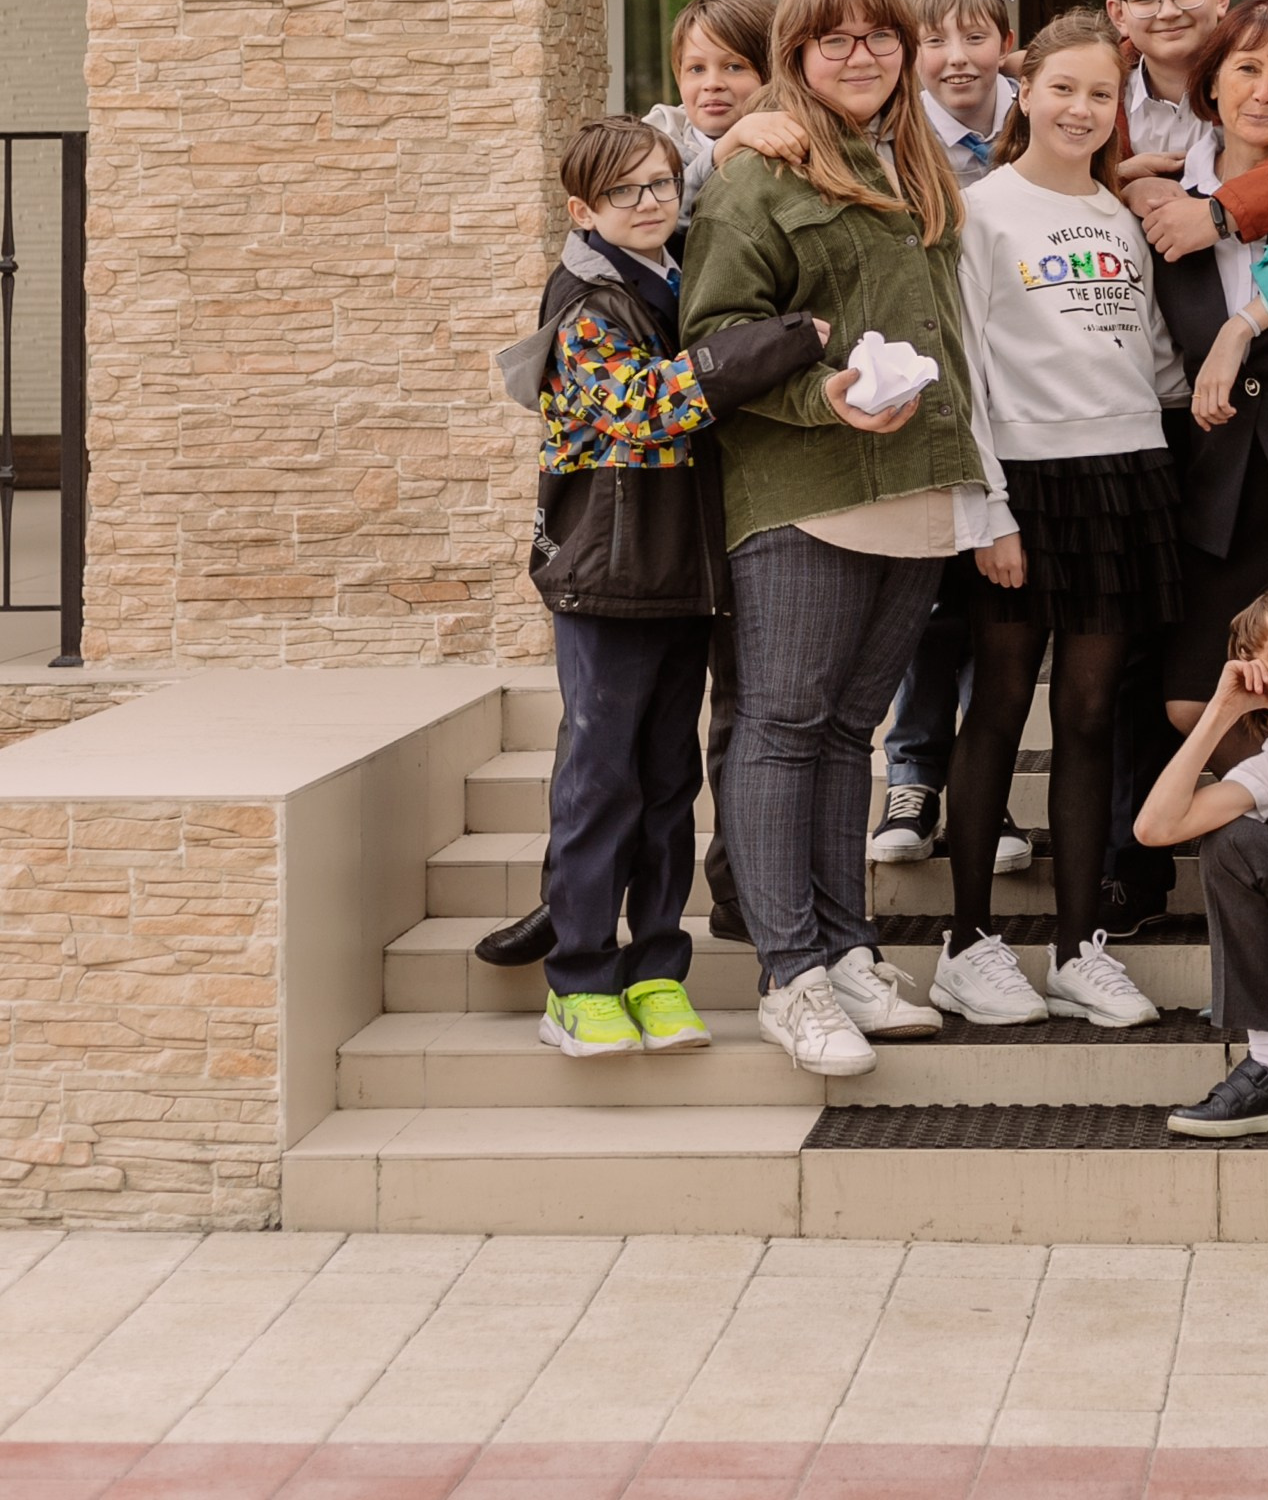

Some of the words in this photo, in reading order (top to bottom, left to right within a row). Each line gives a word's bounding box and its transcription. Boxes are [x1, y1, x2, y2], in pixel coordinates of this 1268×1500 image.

[1047, 226, 1112, 246] WELCOME
[1115, 235, 1129, 252] TO
[1017, 251, 1143, 286] LONDO
[1067, 287, 1090, 301] THE
[1094, 286, 1133, 301] BIGGE
[1095, 303, 1120, 316] CITY
